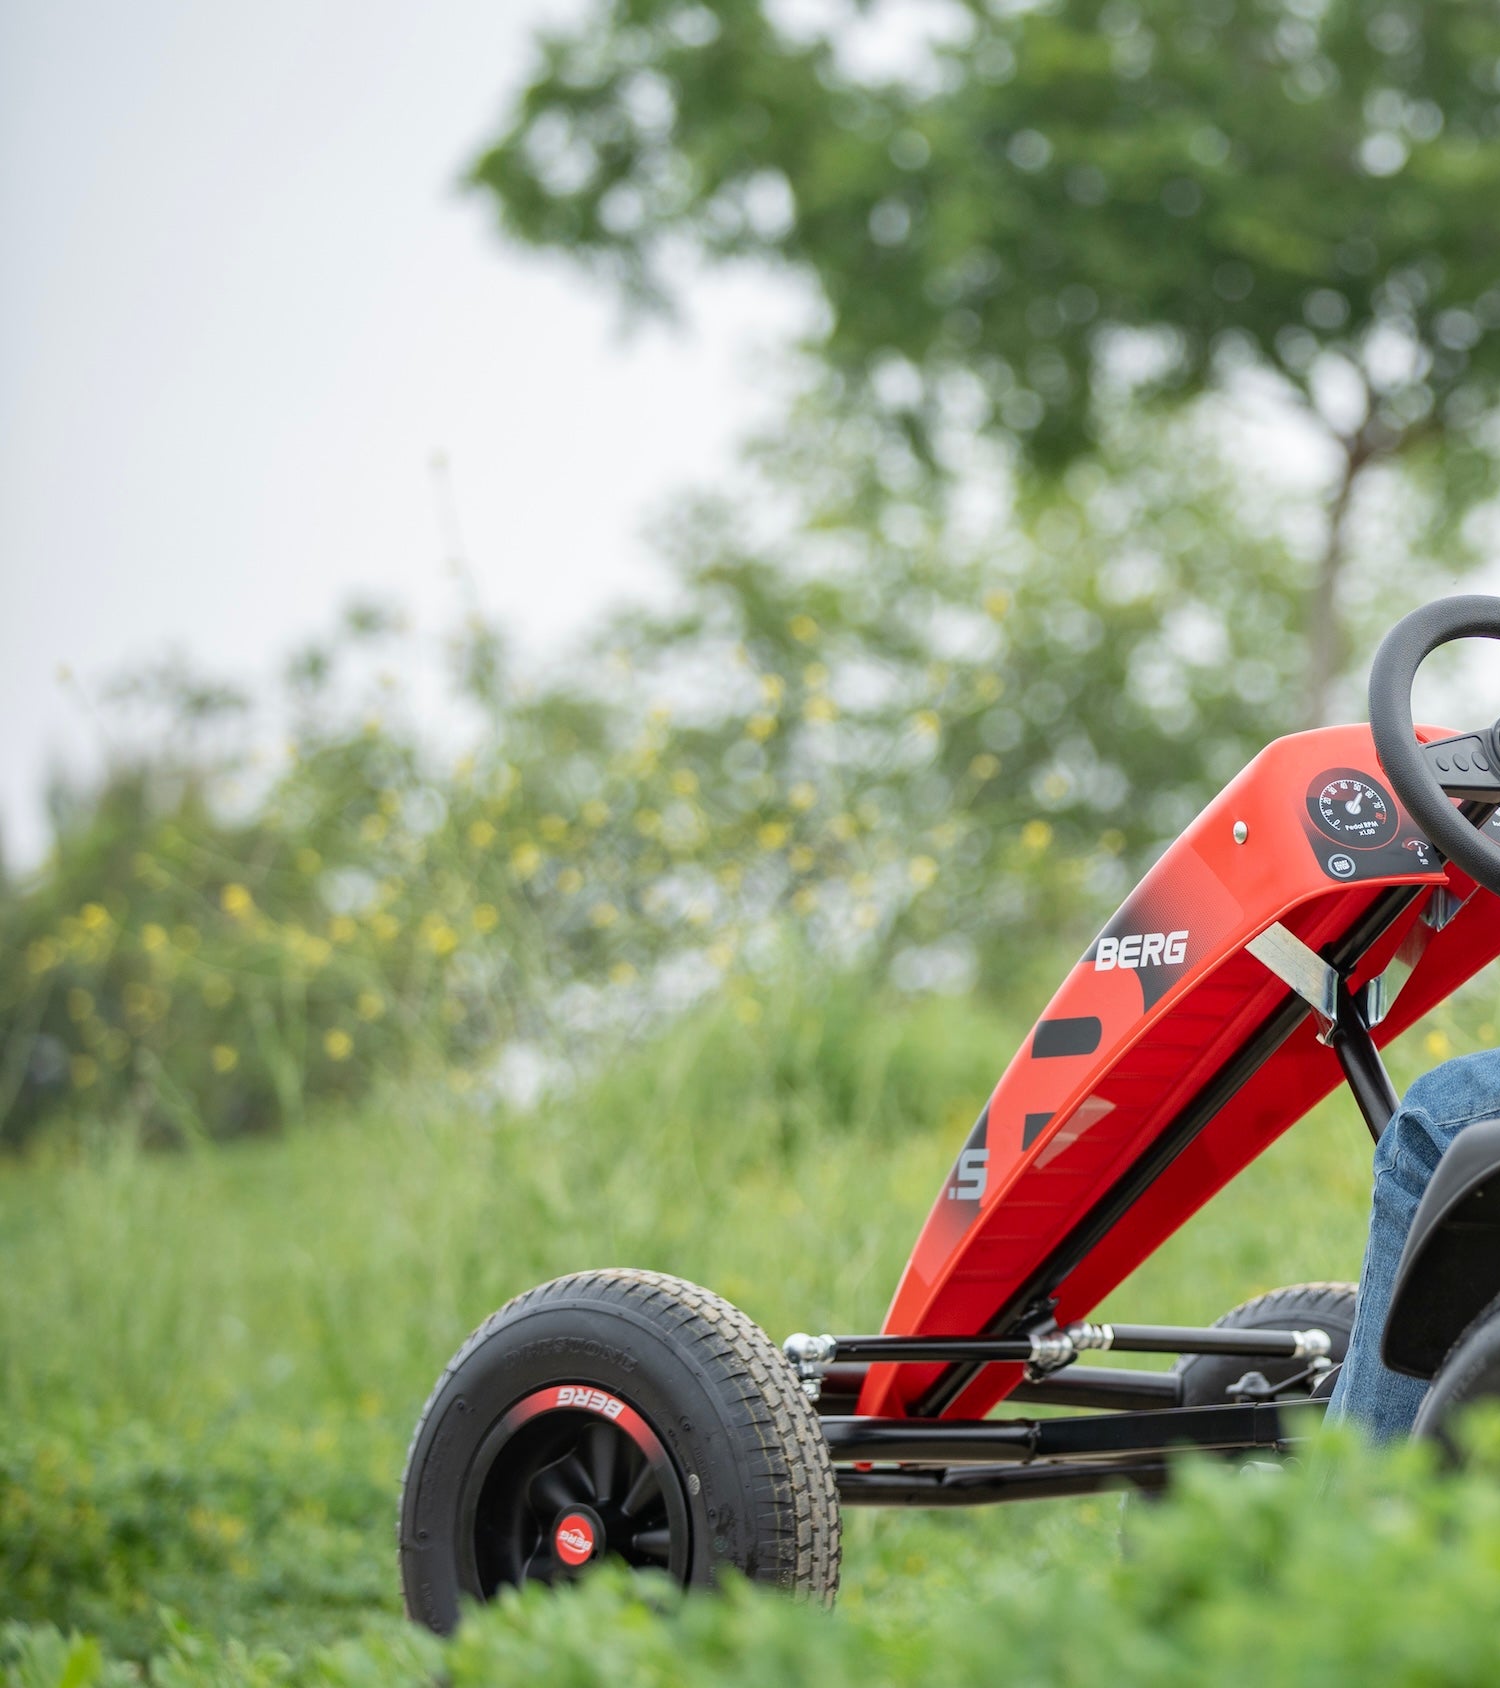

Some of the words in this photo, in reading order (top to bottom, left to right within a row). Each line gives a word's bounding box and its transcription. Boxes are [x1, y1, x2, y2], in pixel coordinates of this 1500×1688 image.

[1344, 821, 1364, 831] Pedal
[1363, 820, 1379, 829] RPM
[1095, 930, 1189, 971] BERG
[555, 1386, 625, 1420] BERG
[557, 1530, 593, 1551] BERG
